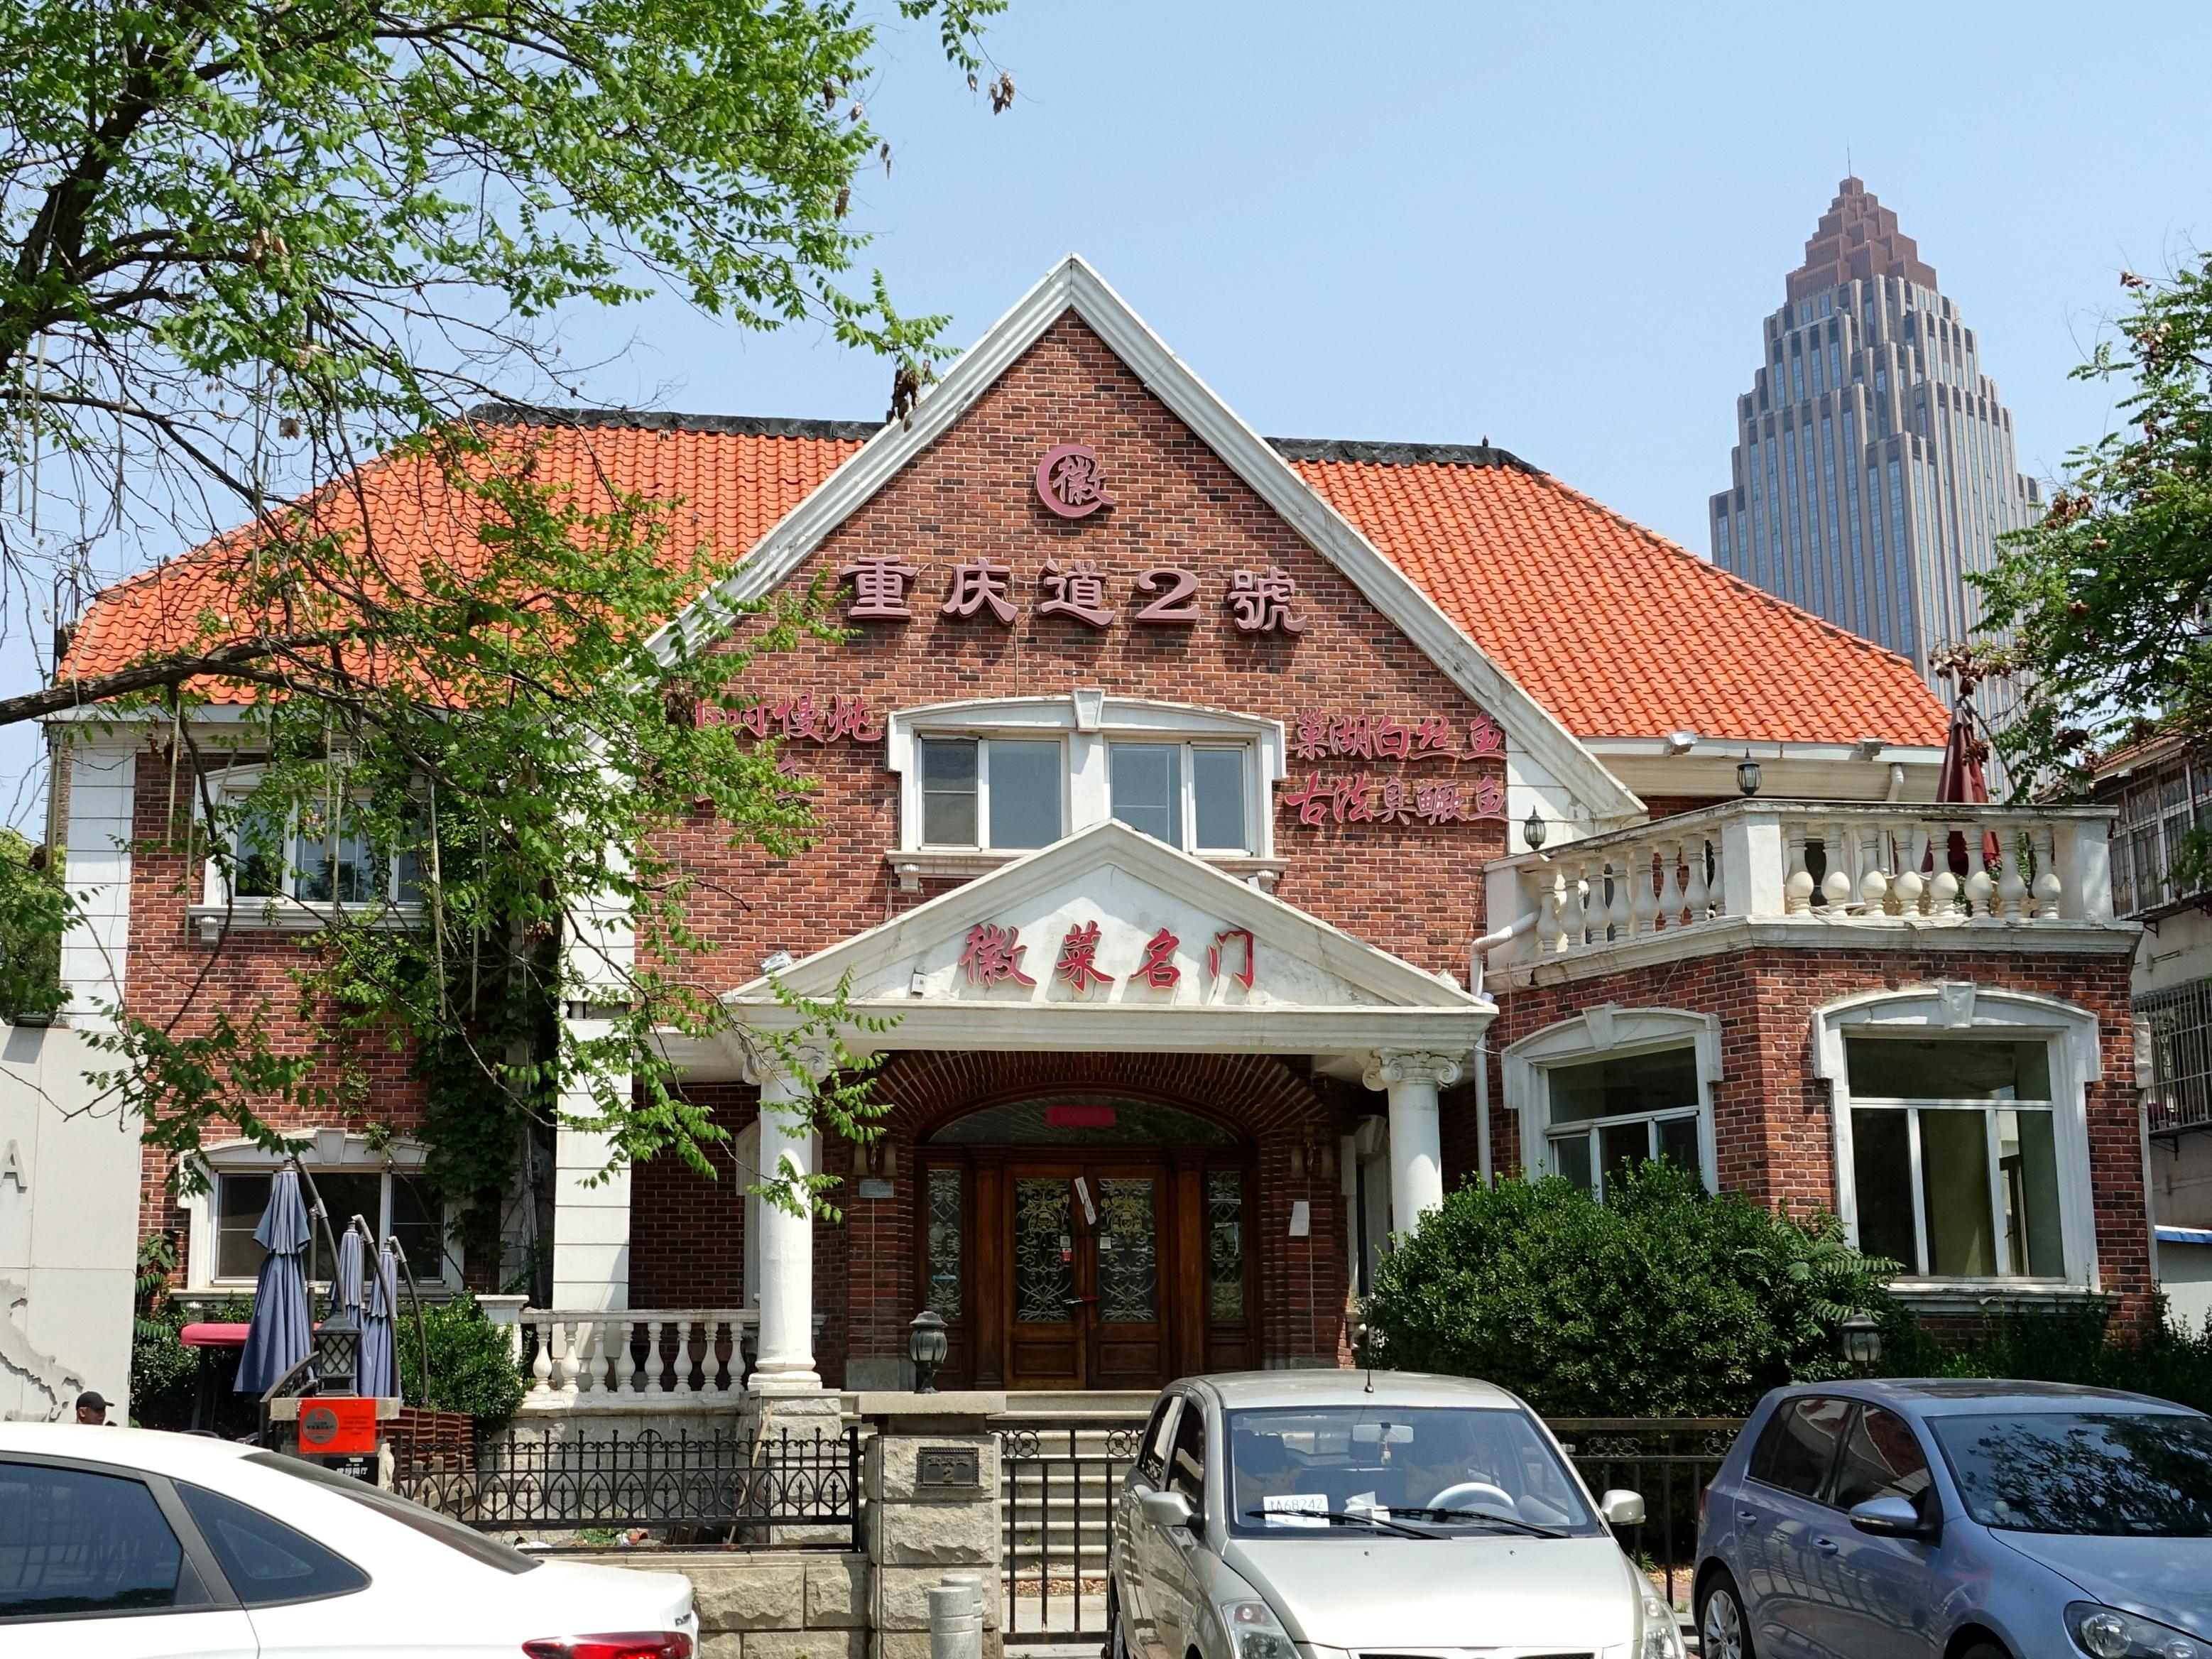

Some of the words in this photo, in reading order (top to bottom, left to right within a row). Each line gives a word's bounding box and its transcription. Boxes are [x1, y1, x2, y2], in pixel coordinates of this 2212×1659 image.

[841, 554, 1307, 635] 重庆道2號
[1290, 707, 1508, 761] 巢湖白丝鱼
[959, 920, 1255, 993] 徽菜名门
